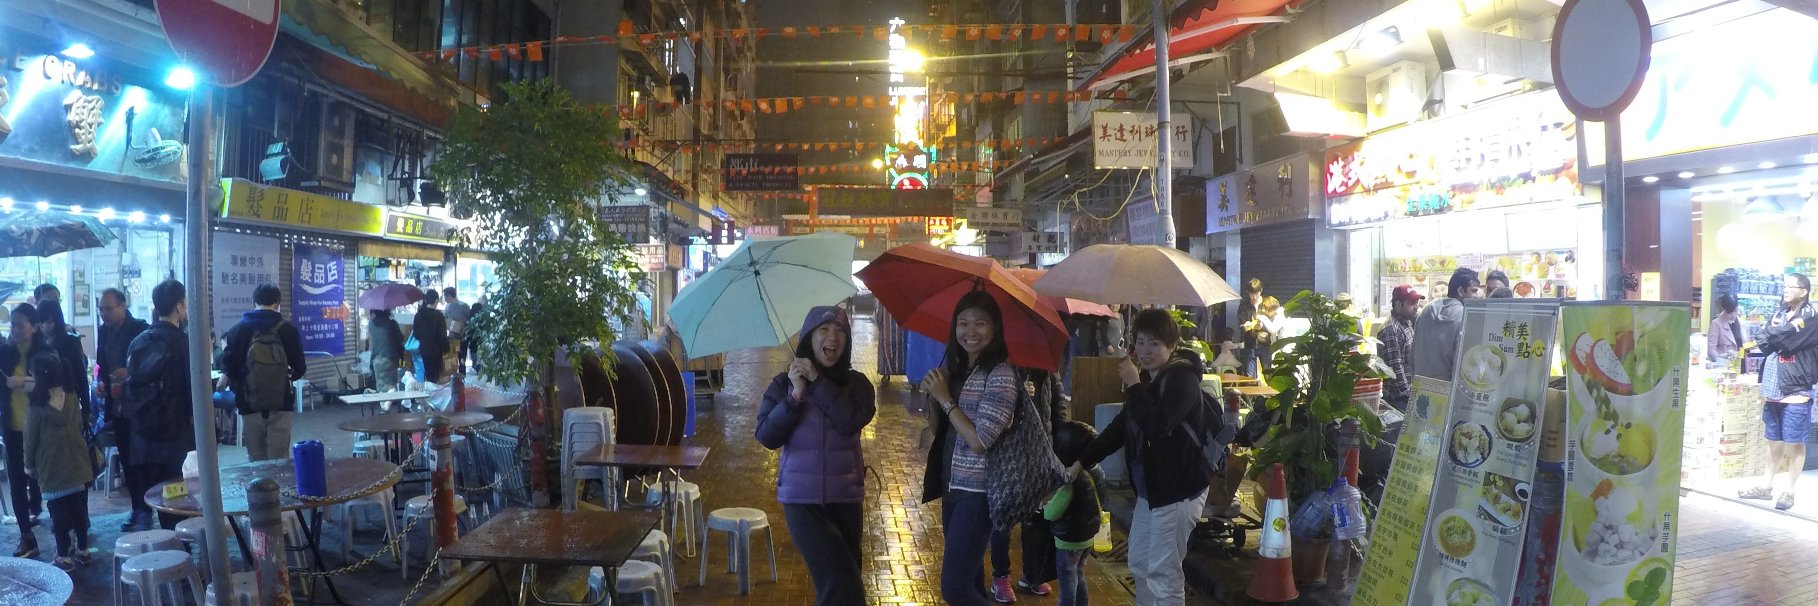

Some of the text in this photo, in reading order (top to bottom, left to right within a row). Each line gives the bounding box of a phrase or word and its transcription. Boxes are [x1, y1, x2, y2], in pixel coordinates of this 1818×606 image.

[1099, 122, 1188, 143] 美達利珠行
[247, 187, 316, 225] 髮品店
[300, 259, 339, 285] 髮品店
[1488, 333, 1503, 343] Dim
[1503, 320, 1529, 340] 精美
[1499, 344, 1514, 353] Sum
[1516, 341, 1546, 359] 點心
